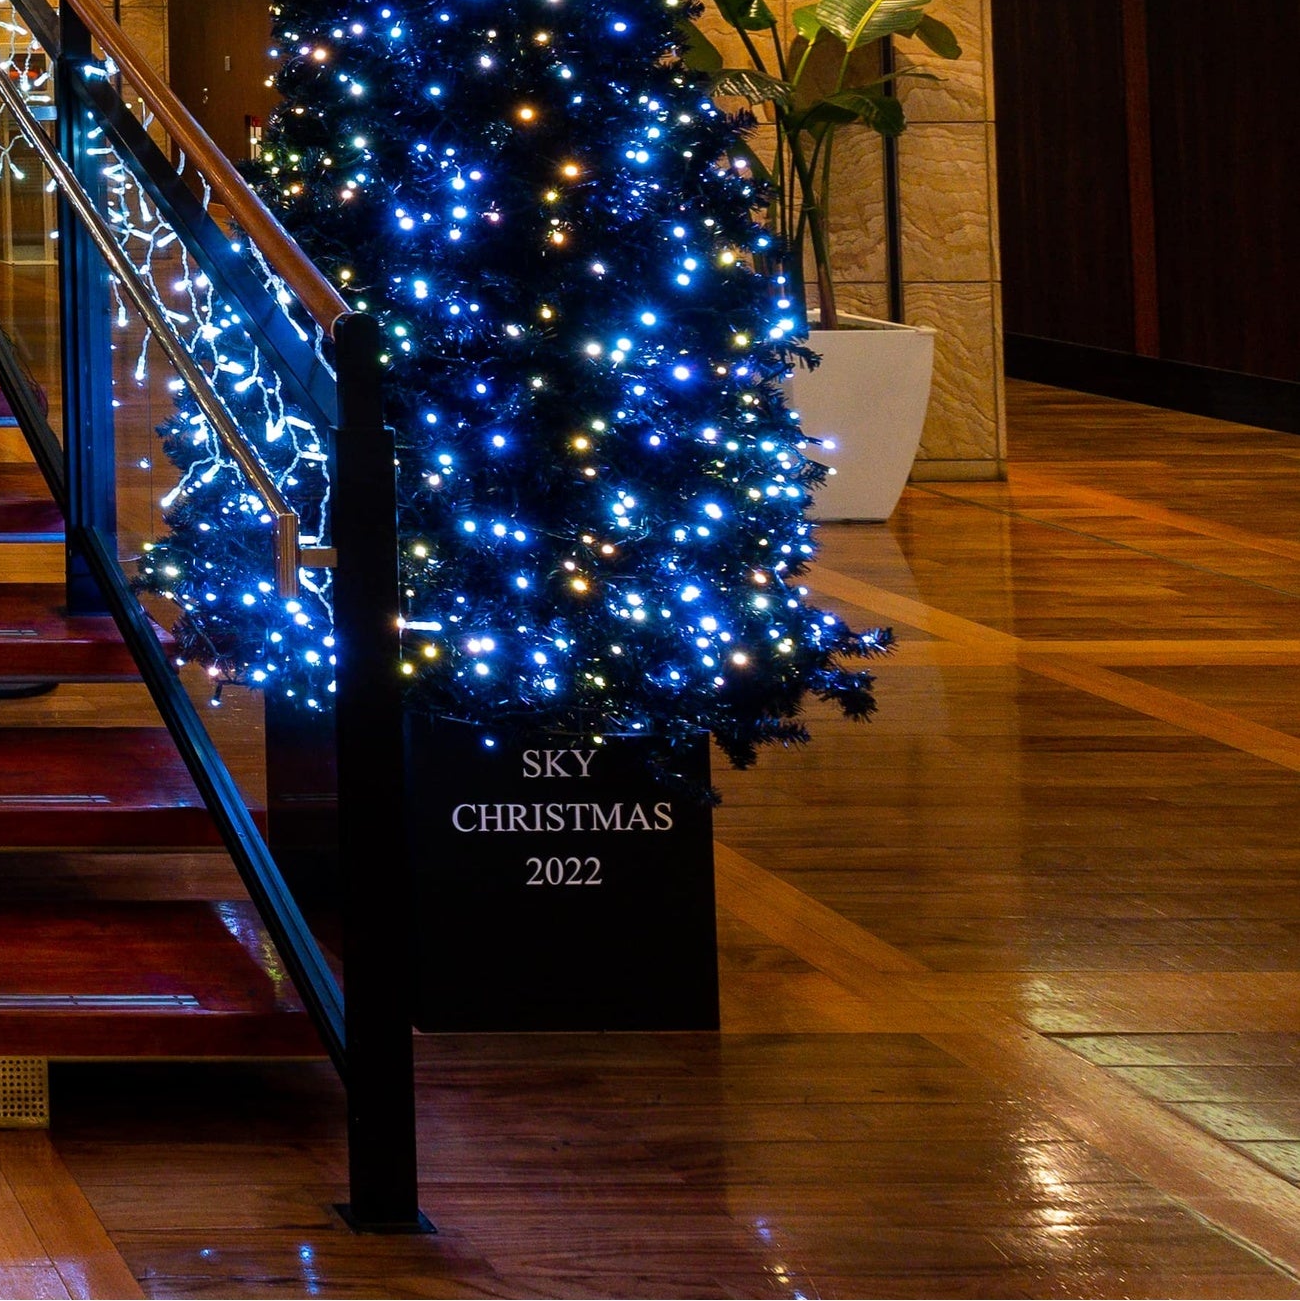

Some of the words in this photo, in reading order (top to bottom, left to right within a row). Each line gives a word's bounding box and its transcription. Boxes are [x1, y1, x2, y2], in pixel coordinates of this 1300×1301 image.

[522, 749, 598, 778] SKY
[451, 802, 674, 832] CHRISTMAS
[525, 856, 603, 886] 2022
